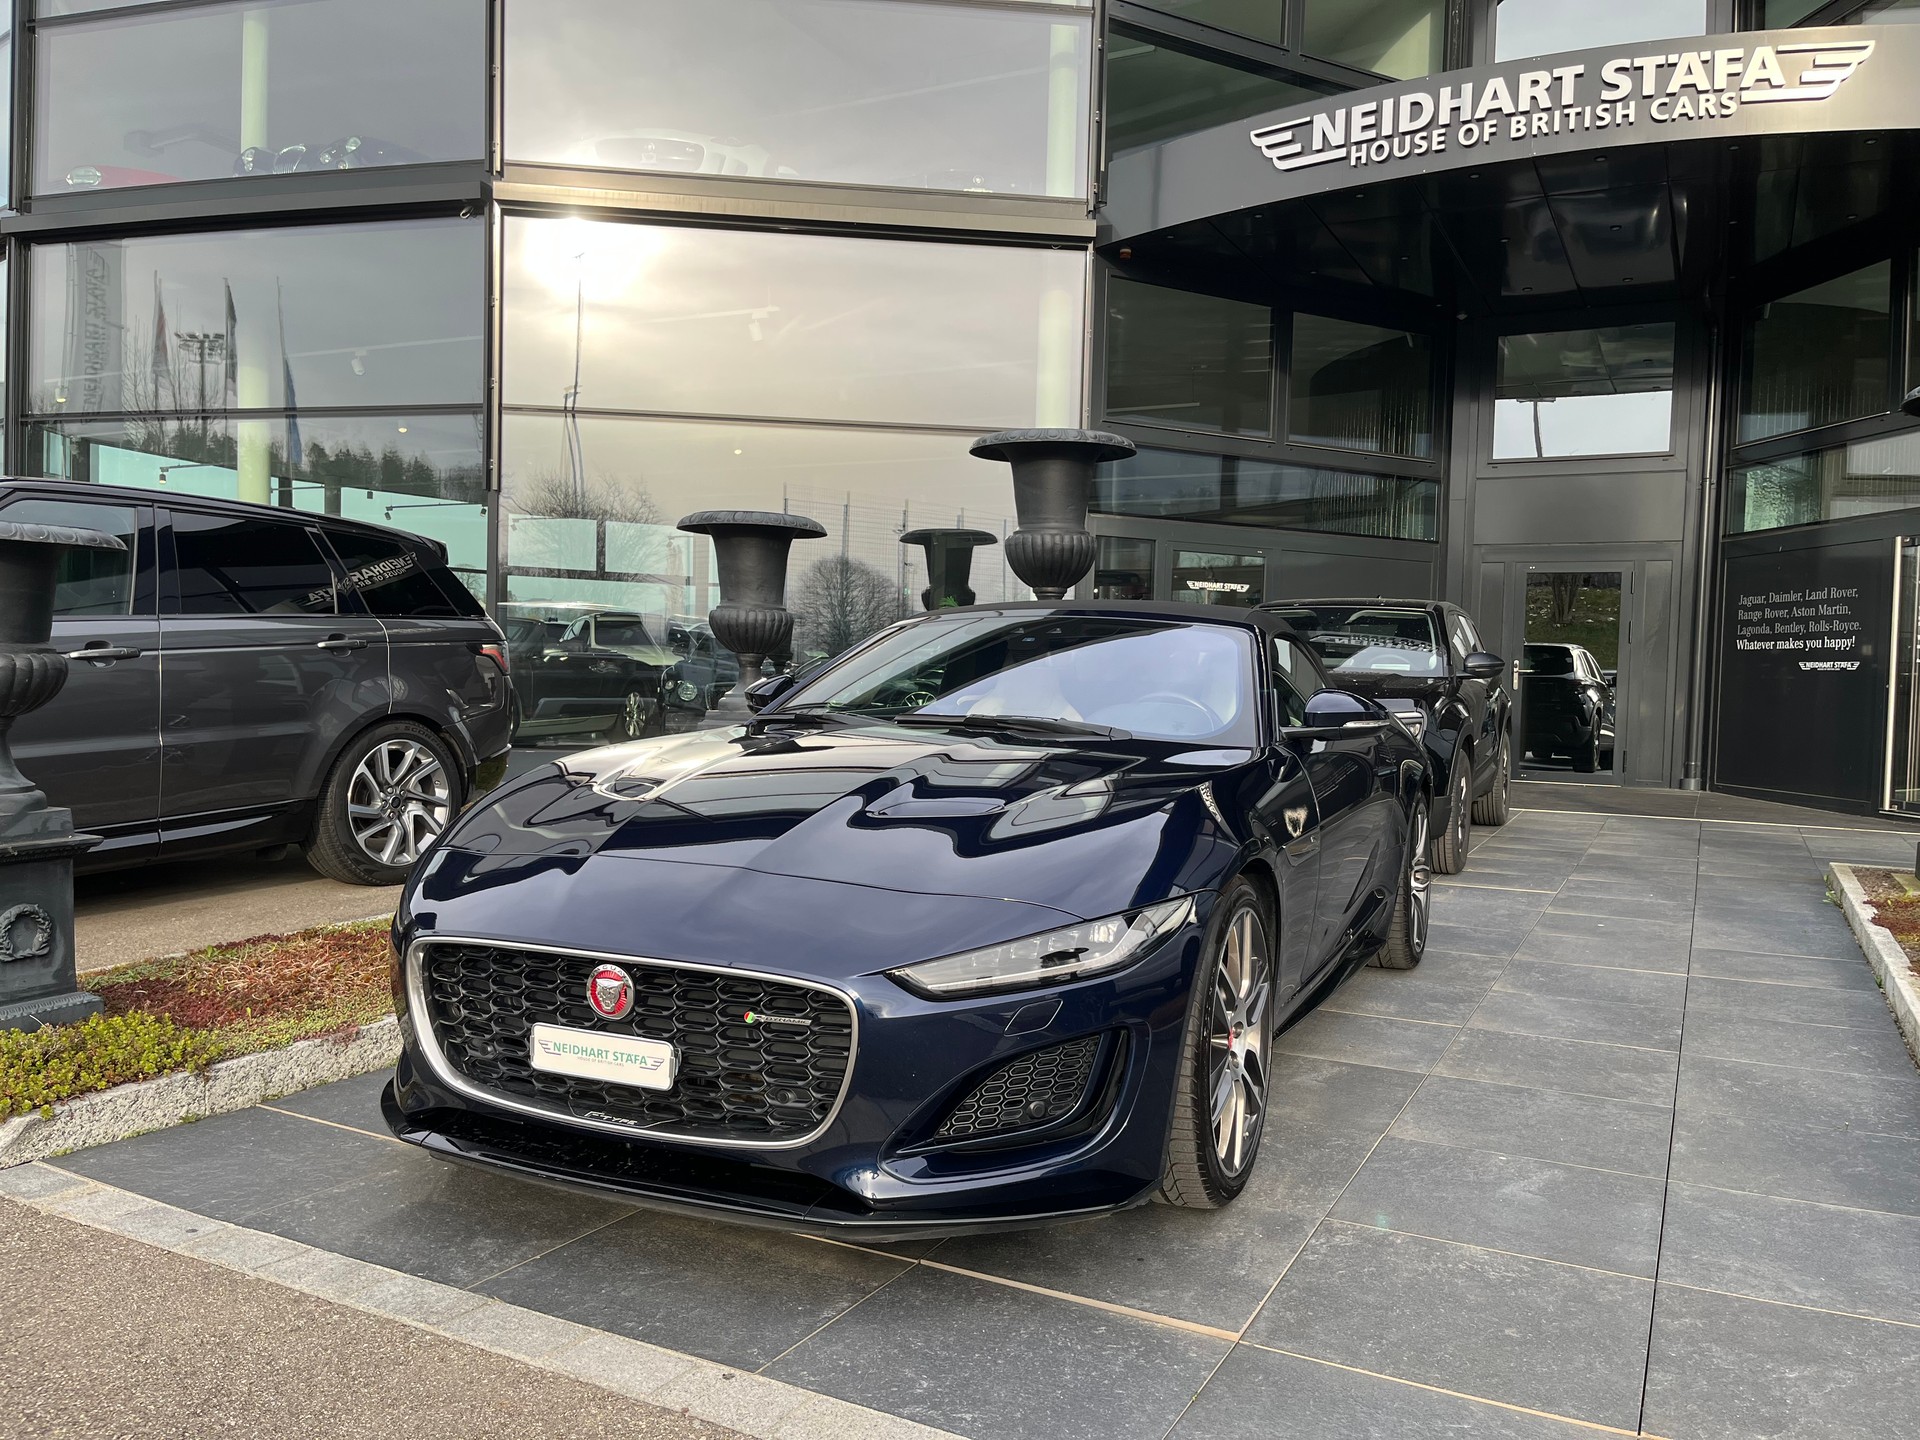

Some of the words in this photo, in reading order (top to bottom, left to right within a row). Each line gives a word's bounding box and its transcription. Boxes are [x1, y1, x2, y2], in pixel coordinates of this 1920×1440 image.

[1310, 64, 1587, 151] NEIDHART
[1601, 45, 1785, 101] STÄFA
[1350, 132, 1446, 167] HOUSE
[1459, 121, 1499, 148] OF
[1509, 98, 1636, 139] BRITISH
[1650, 91, 1739, 122] CARS
[1738, 595, 1767, 607] Jaguar,
[1769, 590, 1803, 603] Daimler,
[1805, 588, 1828, 601] Land
[1830, 587, 1859, 599] Rover,
[1738, 610, 1763, 622] Range
[1764, 608, 1790, 619] Rover,
[1791, 606, 1816, 617] Aston
[1818, 603, 1851, 616] Martin,
[1737, 623, 1772, 637] Lagonda,
[1774, 622, 1807, 635] Bentley,
[1809, 620, 1862, 634] Rolls-Royce.
[1736, 639, 1775, 650] Whatever
[1776, 637, 1804, 650] makes
[1805, 640, 1822, 651] you
[1824, 635, 1856, 651] happy!
[553, 1041, 610, 1060] NEIDHART
[612, 1051, 648, 1066] STÄFA
